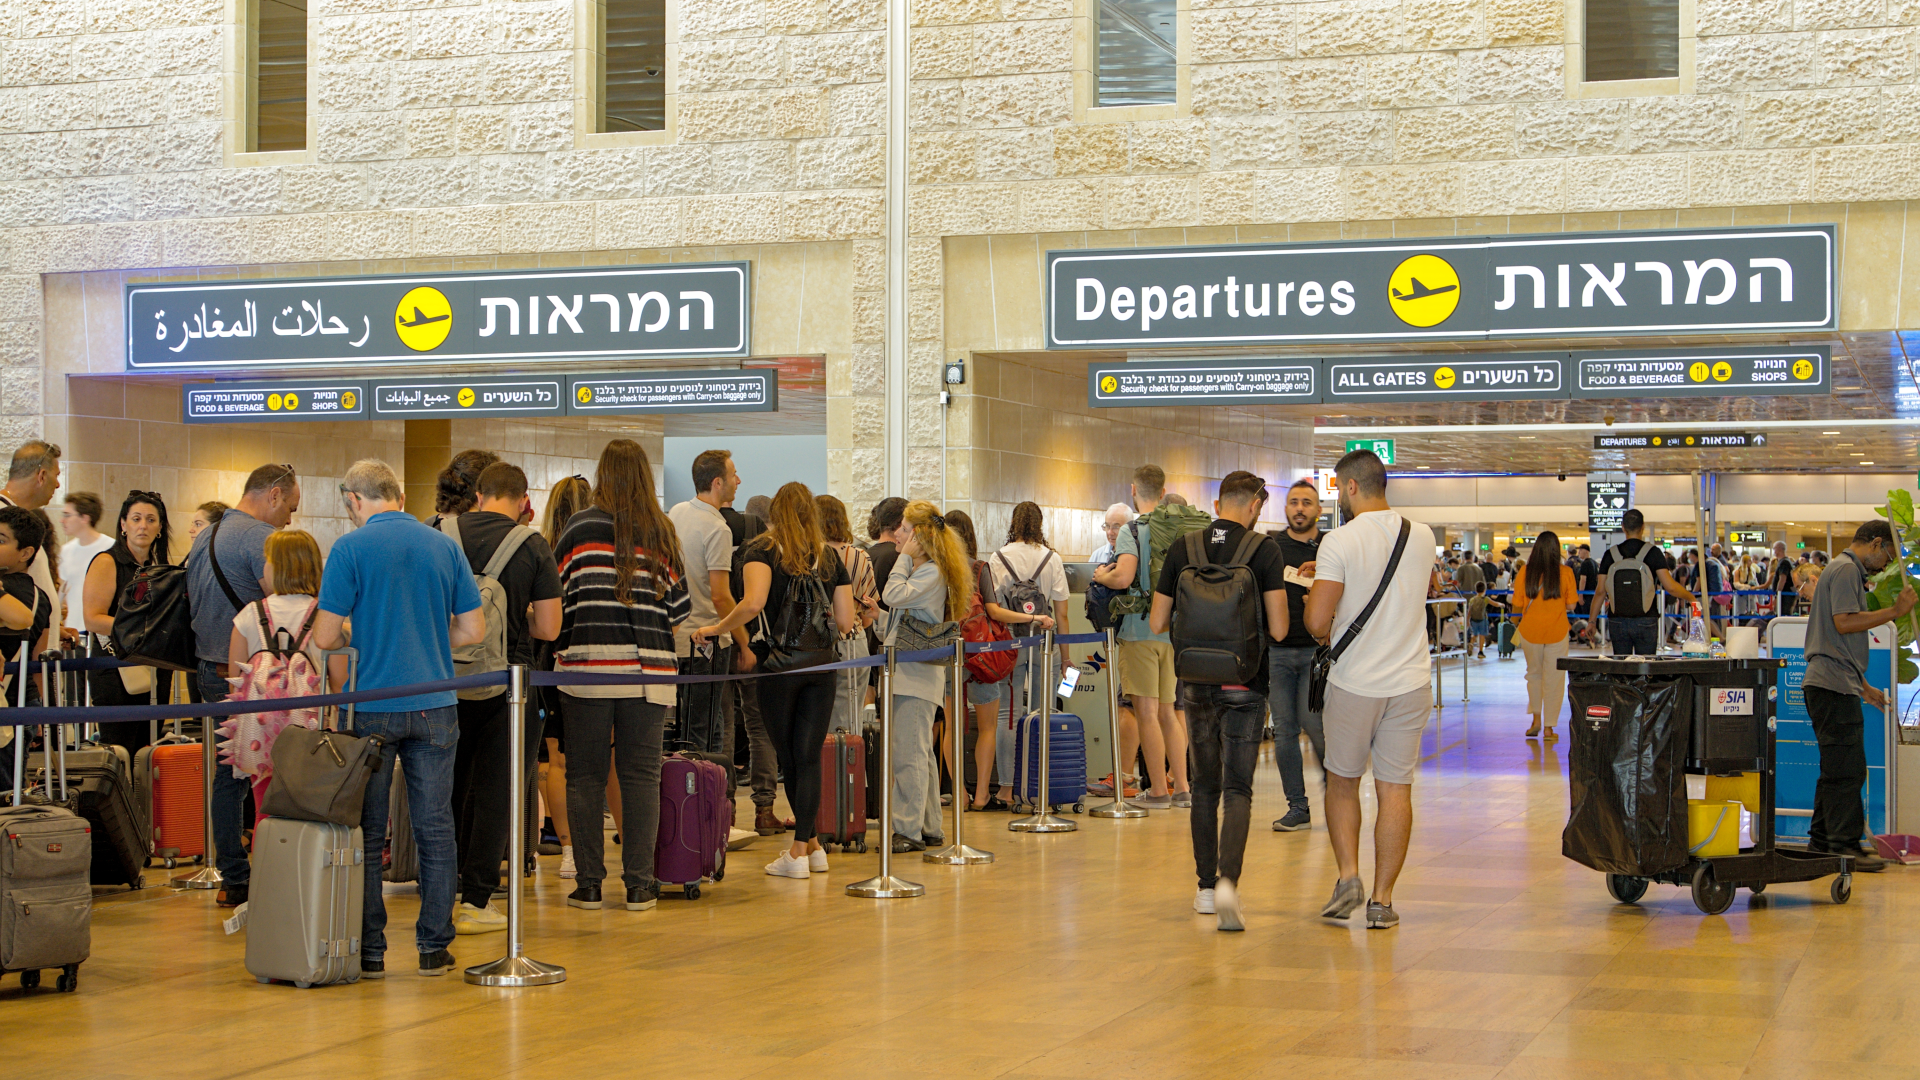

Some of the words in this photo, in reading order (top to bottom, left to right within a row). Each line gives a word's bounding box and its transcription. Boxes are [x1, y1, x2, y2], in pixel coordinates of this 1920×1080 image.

[1495, 258, 1792, 310] המראות
[1076, 276, 1355, 331] Departures
[479, 291, 713, 336] המראות
[155, 299, 257, 352] المغادرة
[273, 299, 369, 347] رحلات
[1587, 363, 1611, 375] קפה
[1613, 362, 1637, 372] ובתי
[1639, 361, 1685, 372] מסעדות
[1753, 359, 1787, 369] חנויות
[1190, 375, 1203, 383] עם
[1206, 373, 1243, 383] לנוסעים
[1284, 373, 1309, 381] בידוק
[1339, 373, 1369, 386] ALL
[1373, 372, 1426, 386] GATES
[1463, 370, 1528, 385] השערים
[1534, 366, 1553, 382] כל
[1588, 375, 1617, 385] FOOD
[1618, 375, 1627, 385] &
[1629, 373, 1685, 384] BEVERAGE
[1751, 371, 1788, 382] SHOPS
[1121, 375, 1143, 384] בלבד
[595, 386, 615, 394] בלבד
[628, 386, 652, 395] כבודת
[670, 383, 703, 393] לנוסעים
[739, 383, 761, 392] בידוק
[1121, 385, 1147, 394] Security
[1149, 384, 1168, 392] check
[1181, 382, 1219, 393] passengers
[1219, 381, 1235, 390] with
[1234, 381, 1264, 392] Carry-on
[1266, 380, 1293, 392] baggage
[1294, 382, 1309, 391] only
[194, 394, 212, 404] קפה
[213, 393, 231, 402] ובתי
[231, 392, 265, 402] מסעדות
[313, 391, 338, 400] חנויות
[386, 391, 420, 405] البوابات
[424, 394, 450, 406] جميع
[483, 391, 533, 404] השערים
[536, 389, 551, 401] כל
[595, 395, 619, 403] Security
[646, 392, 681, 403] passengers
[682, 391, 697, 400] with
[696, 393, 722, 401] Carry-on
[723, 390, 747, 401] baggage
[748, 391, 761, 400] only
[195, 404, 217, 413] FOOD
[217, 404, 224, 413] &
[224, 403, 265, 412] BEVERAGE
[311, 401, 339, 411] SHOPS
[1600, 437, 1648, 446] DEPARTURES
[1701, 436, 1745, 445] המראות
[1723, 705, 1740, 713] ניקיון
